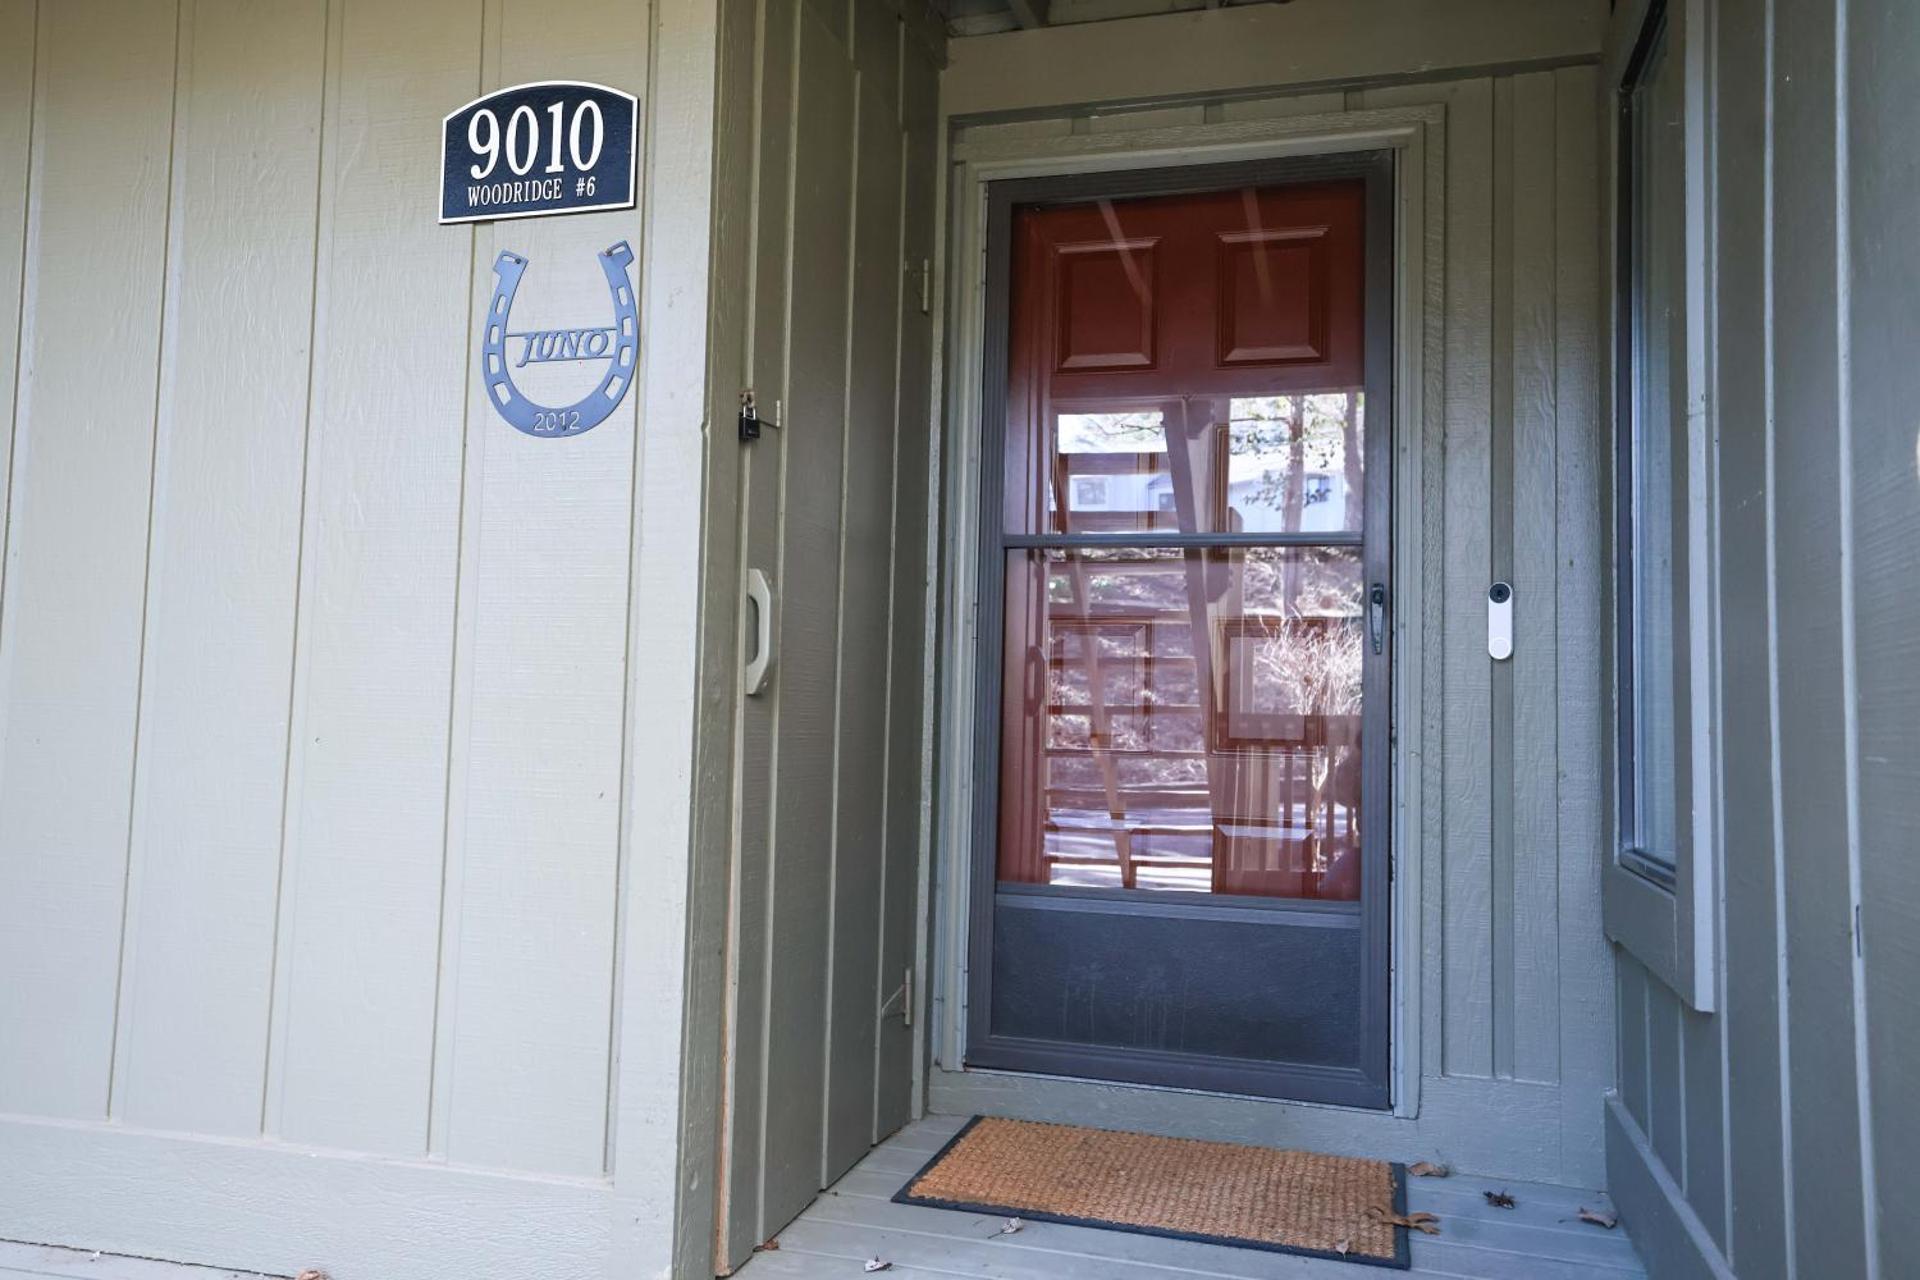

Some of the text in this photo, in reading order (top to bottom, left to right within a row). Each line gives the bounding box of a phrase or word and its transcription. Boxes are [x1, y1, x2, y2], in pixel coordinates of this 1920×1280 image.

[468, 100, 604, 179] 9010
[468, 176, 596, 207] WOODRIDGE #6
[516, 329, 609, 368] JUNO
[534, 411, 580, 431] 2012
